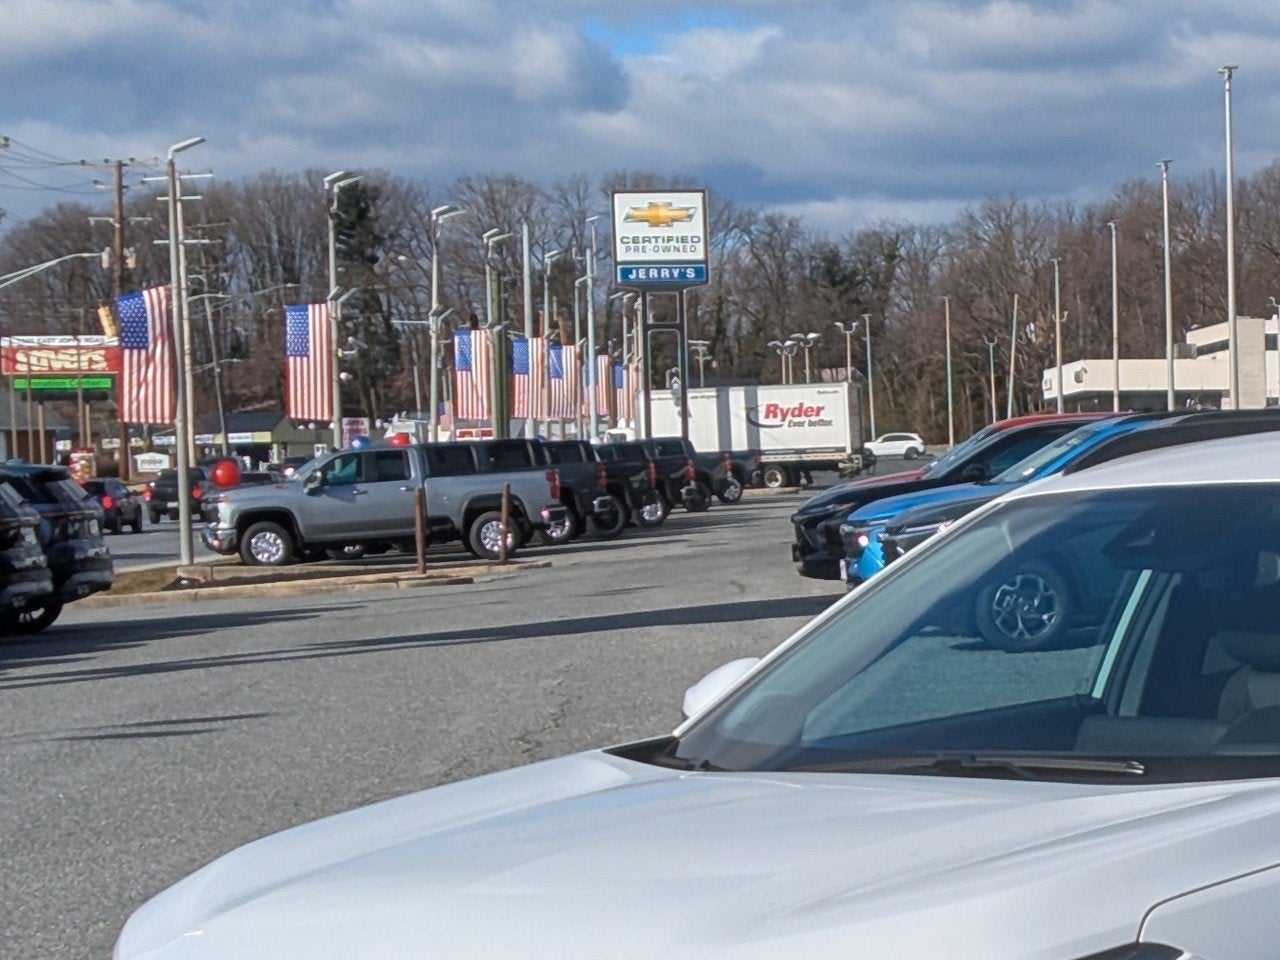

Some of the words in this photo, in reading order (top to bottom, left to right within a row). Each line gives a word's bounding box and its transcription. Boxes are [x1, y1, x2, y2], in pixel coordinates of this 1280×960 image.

[620, 235, 701, 245] CERTIFIED
[625, 245, 697, 254] PRE-OWNED
[628, 268, 696, 280] JERRY'S
[764, 402, 825, 422] Ryder
